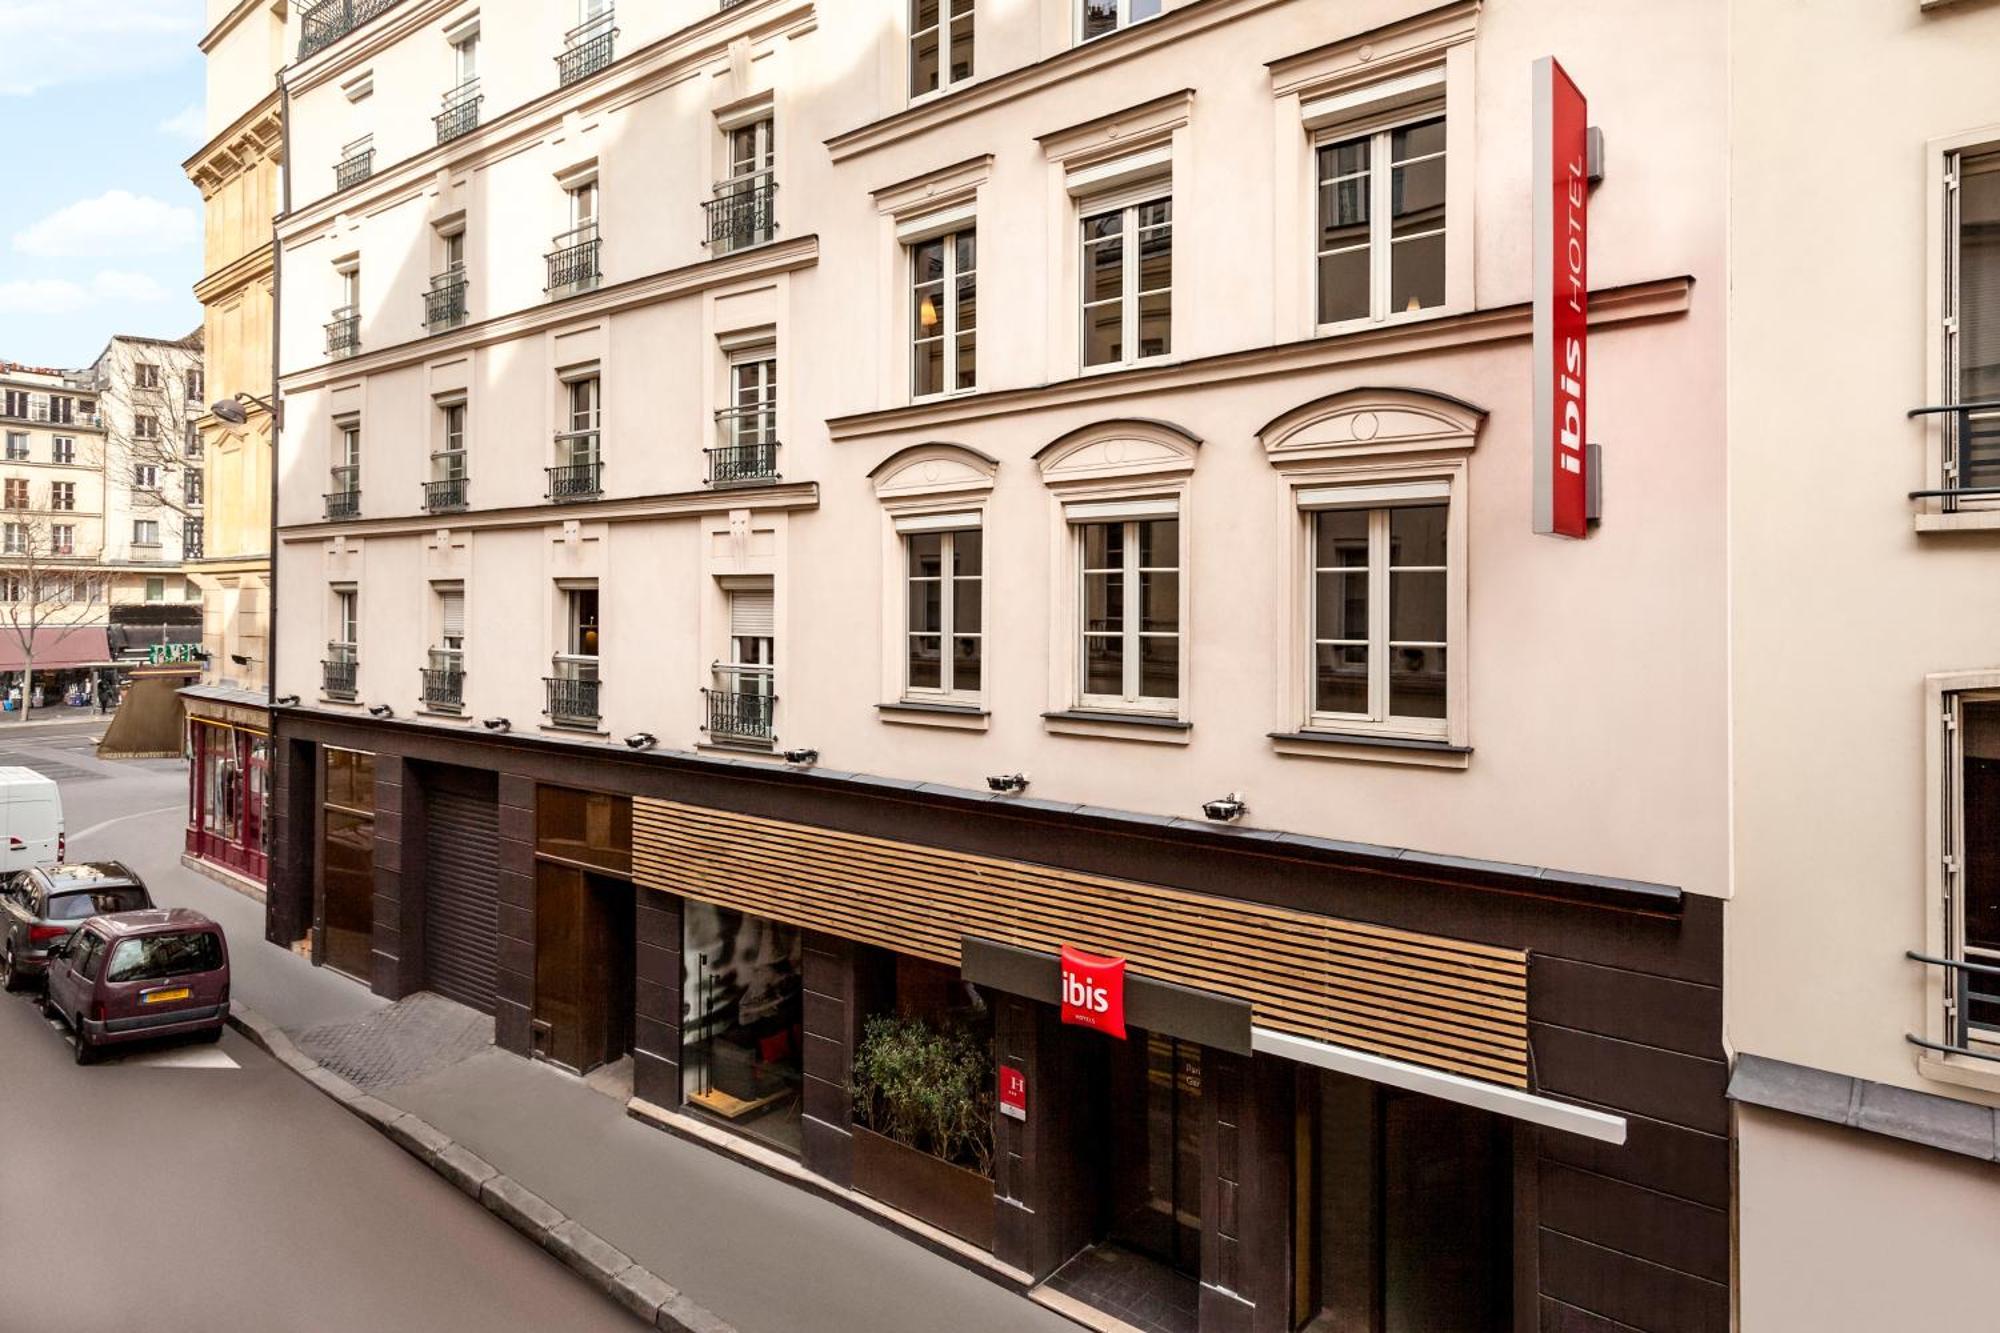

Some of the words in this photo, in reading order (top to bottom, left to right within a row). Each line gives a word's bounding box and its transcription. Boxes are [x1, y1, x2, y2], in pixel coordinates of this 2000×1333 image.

[1568, 155, 1582, 313] HOTEL
[1561, 337, 1581, 475] ibis
[1063, 970, 1109, 1013] ibis
[1011, 1076, 1024, 1092] H
